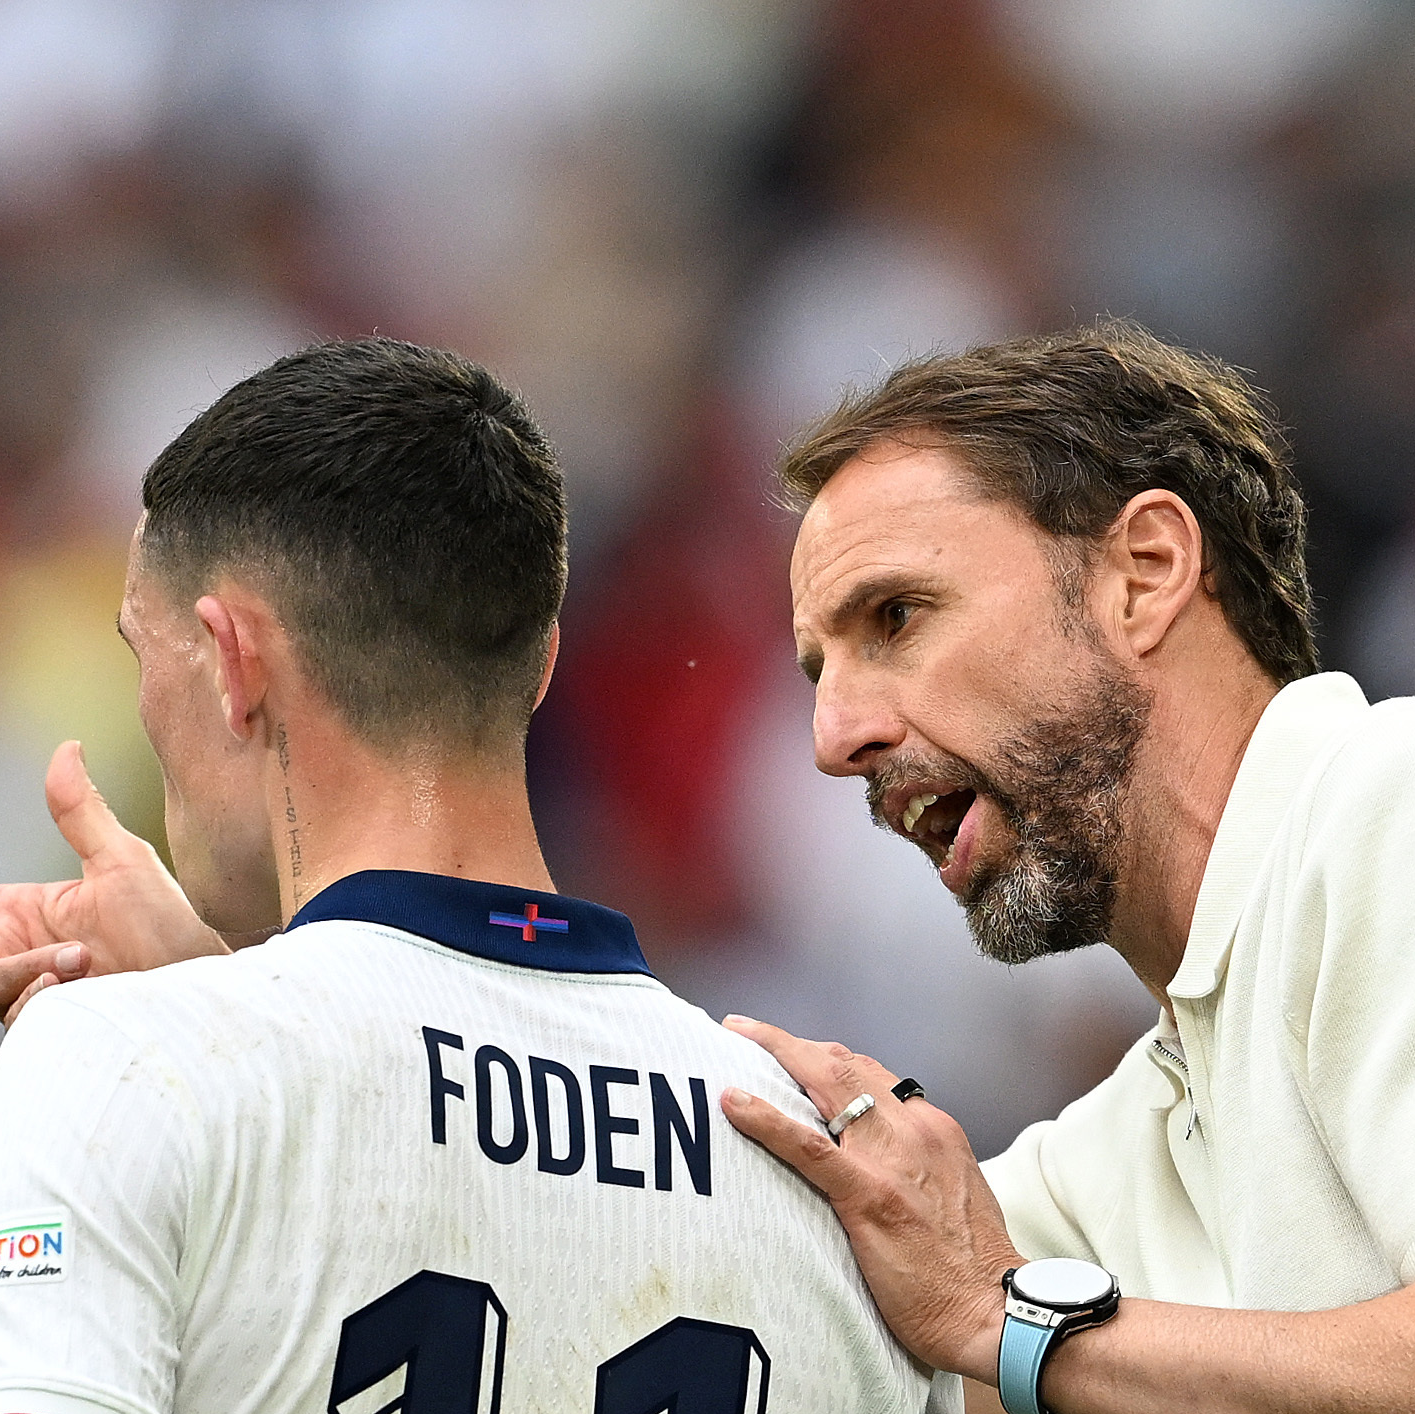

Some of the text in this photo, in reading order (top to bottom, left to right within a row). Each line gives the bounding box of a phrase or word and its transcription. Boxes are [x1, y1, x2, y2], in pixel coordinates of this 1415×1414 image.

[285, 786, 297, 823] IS
[289, 829, 302, 878] THE
[422, 1025, 713, 1197] FODEN
[17, 1263, 62, 1278] children
